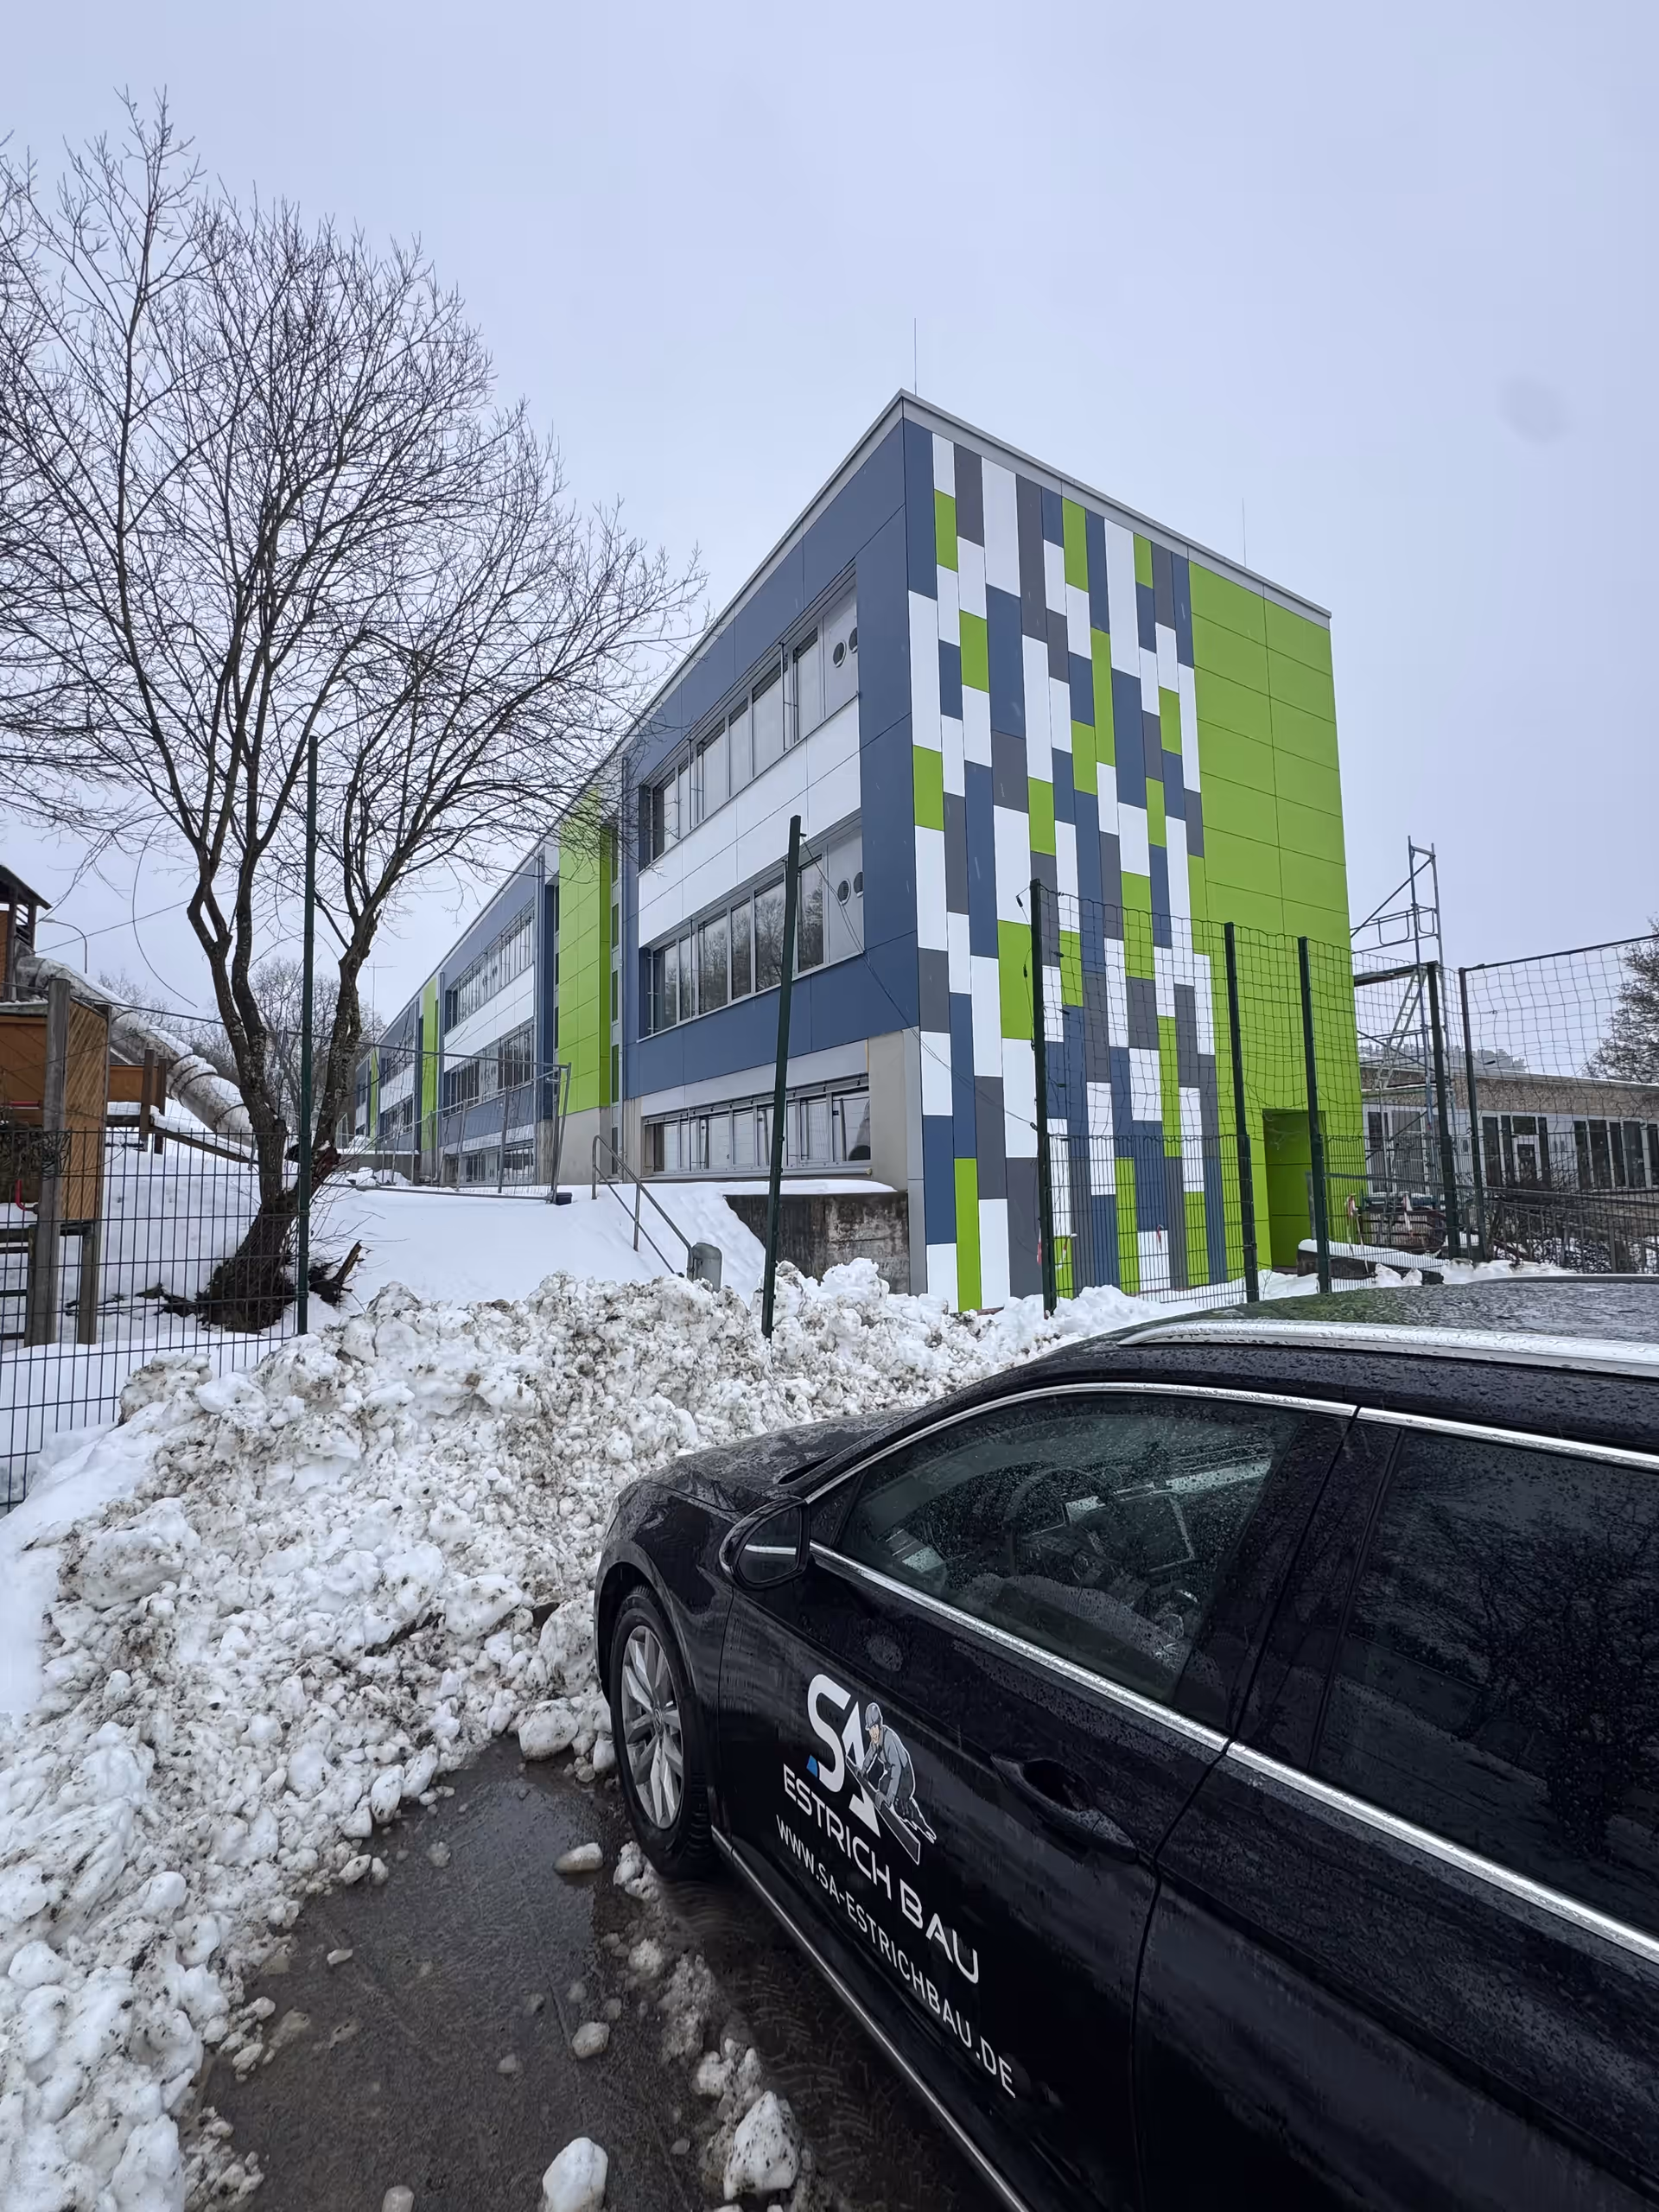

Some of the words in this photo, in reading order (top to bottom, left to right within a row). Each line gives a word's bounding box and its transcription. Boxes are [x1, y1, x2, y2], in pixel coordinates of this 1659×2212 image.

[806, 1674, 880, 1837] SA
[776, 1815, 1015, 2099] WWW.SA-ESTRICHBAU.DE
[783, 1764, 892, 1900] ESTRICH
[899, 1878, 979, 1984] BAU
